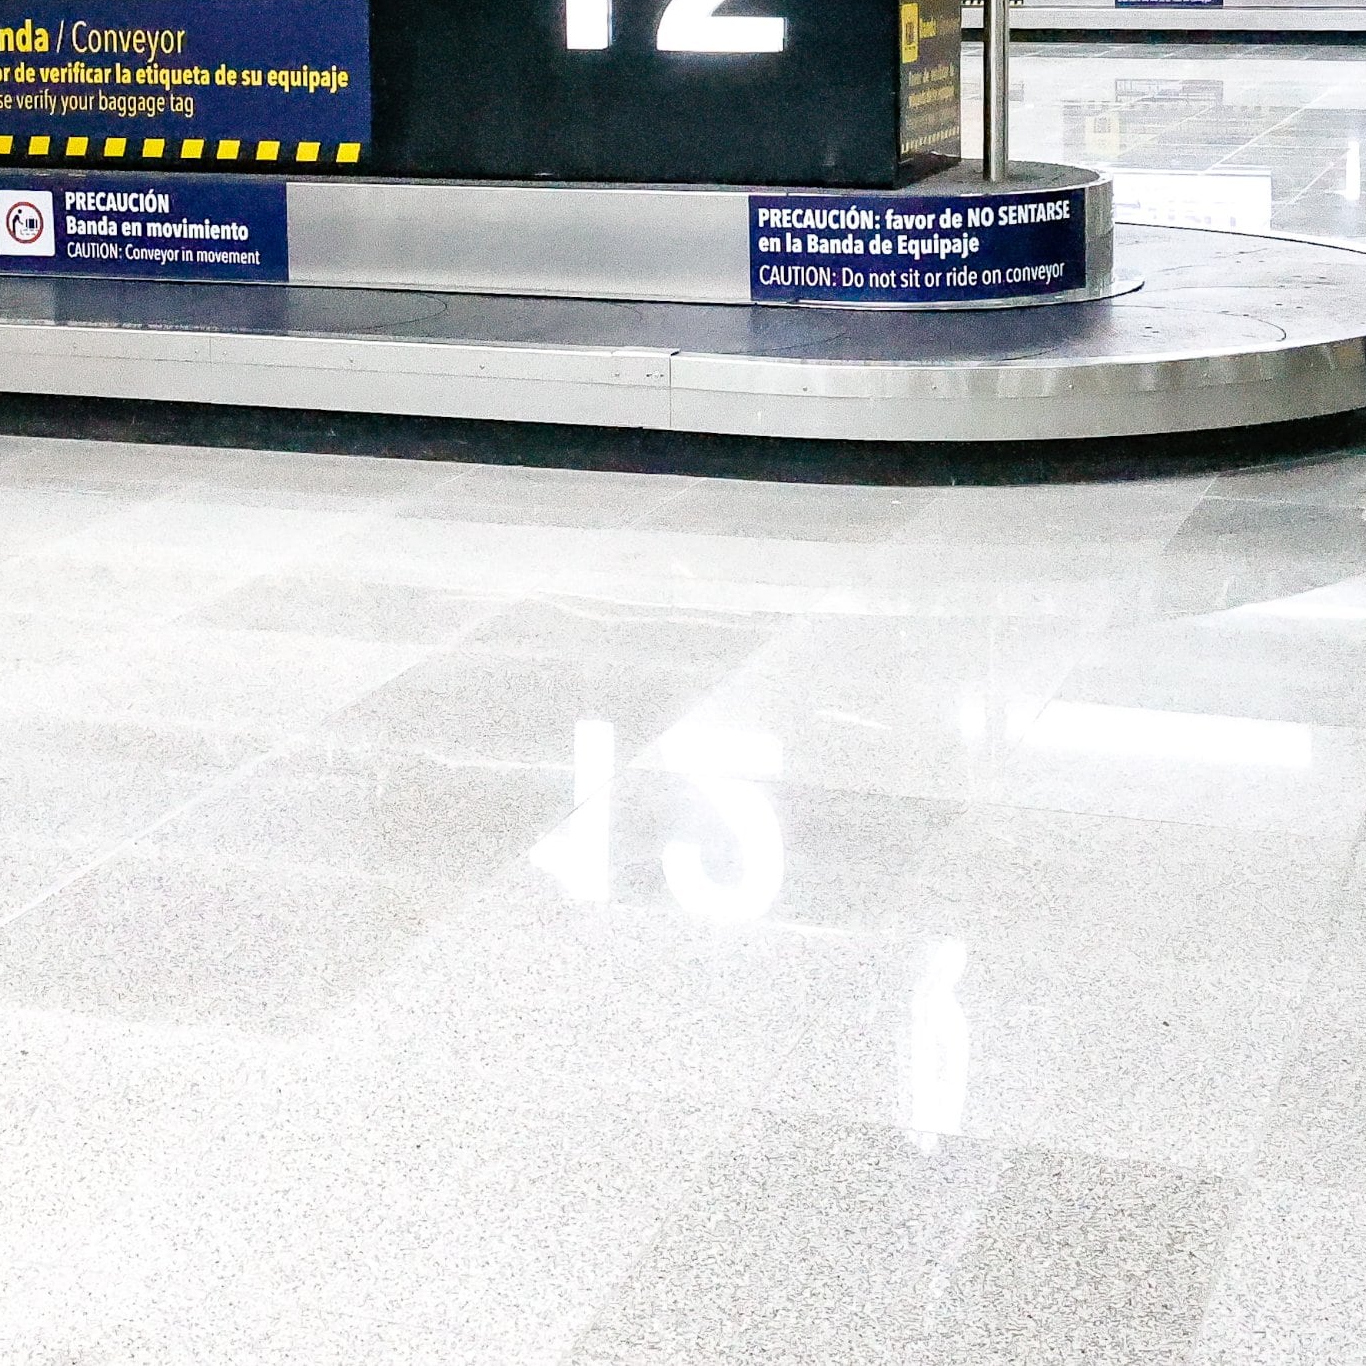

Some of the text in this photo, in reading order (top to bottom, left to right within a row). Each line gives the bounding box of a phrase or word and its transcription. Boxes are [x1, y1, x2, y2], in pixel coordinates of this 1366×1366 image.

[56, 21, 65, 53] /
[71, 22, 186, 63] Conveyor
[14, 63, 36, 84] de
[39, 65, 110, 86] verificar
[115, 65, 132, 85] la
[135, 66, 210, 91] etiqueta
[214, 67, 237, 87] de
[241, 71, 263, 87] su
[266, 66, 349, 94] equipaje
[15, 90, 57, 115] verify
[61, 96, 96, 116] your
[99, 92, 166, 118] baggage
[170, 95, 194, 118] tag
[65, 189, 170, 214] PRECAUCIÓN
[758, 200, 1070, 230] PRECAUCIÓN: favor de NO SENTARSE
[66, 216, 249, 241] Banda en movimiento
[67, 241, 260, 266] CAUTION: Conveyor in movement
[758, 233, 980, 260] en la Banda de Equipaje
[759, 261, 1064, 290] CAUTION: Do not sit or ride on conveyor
